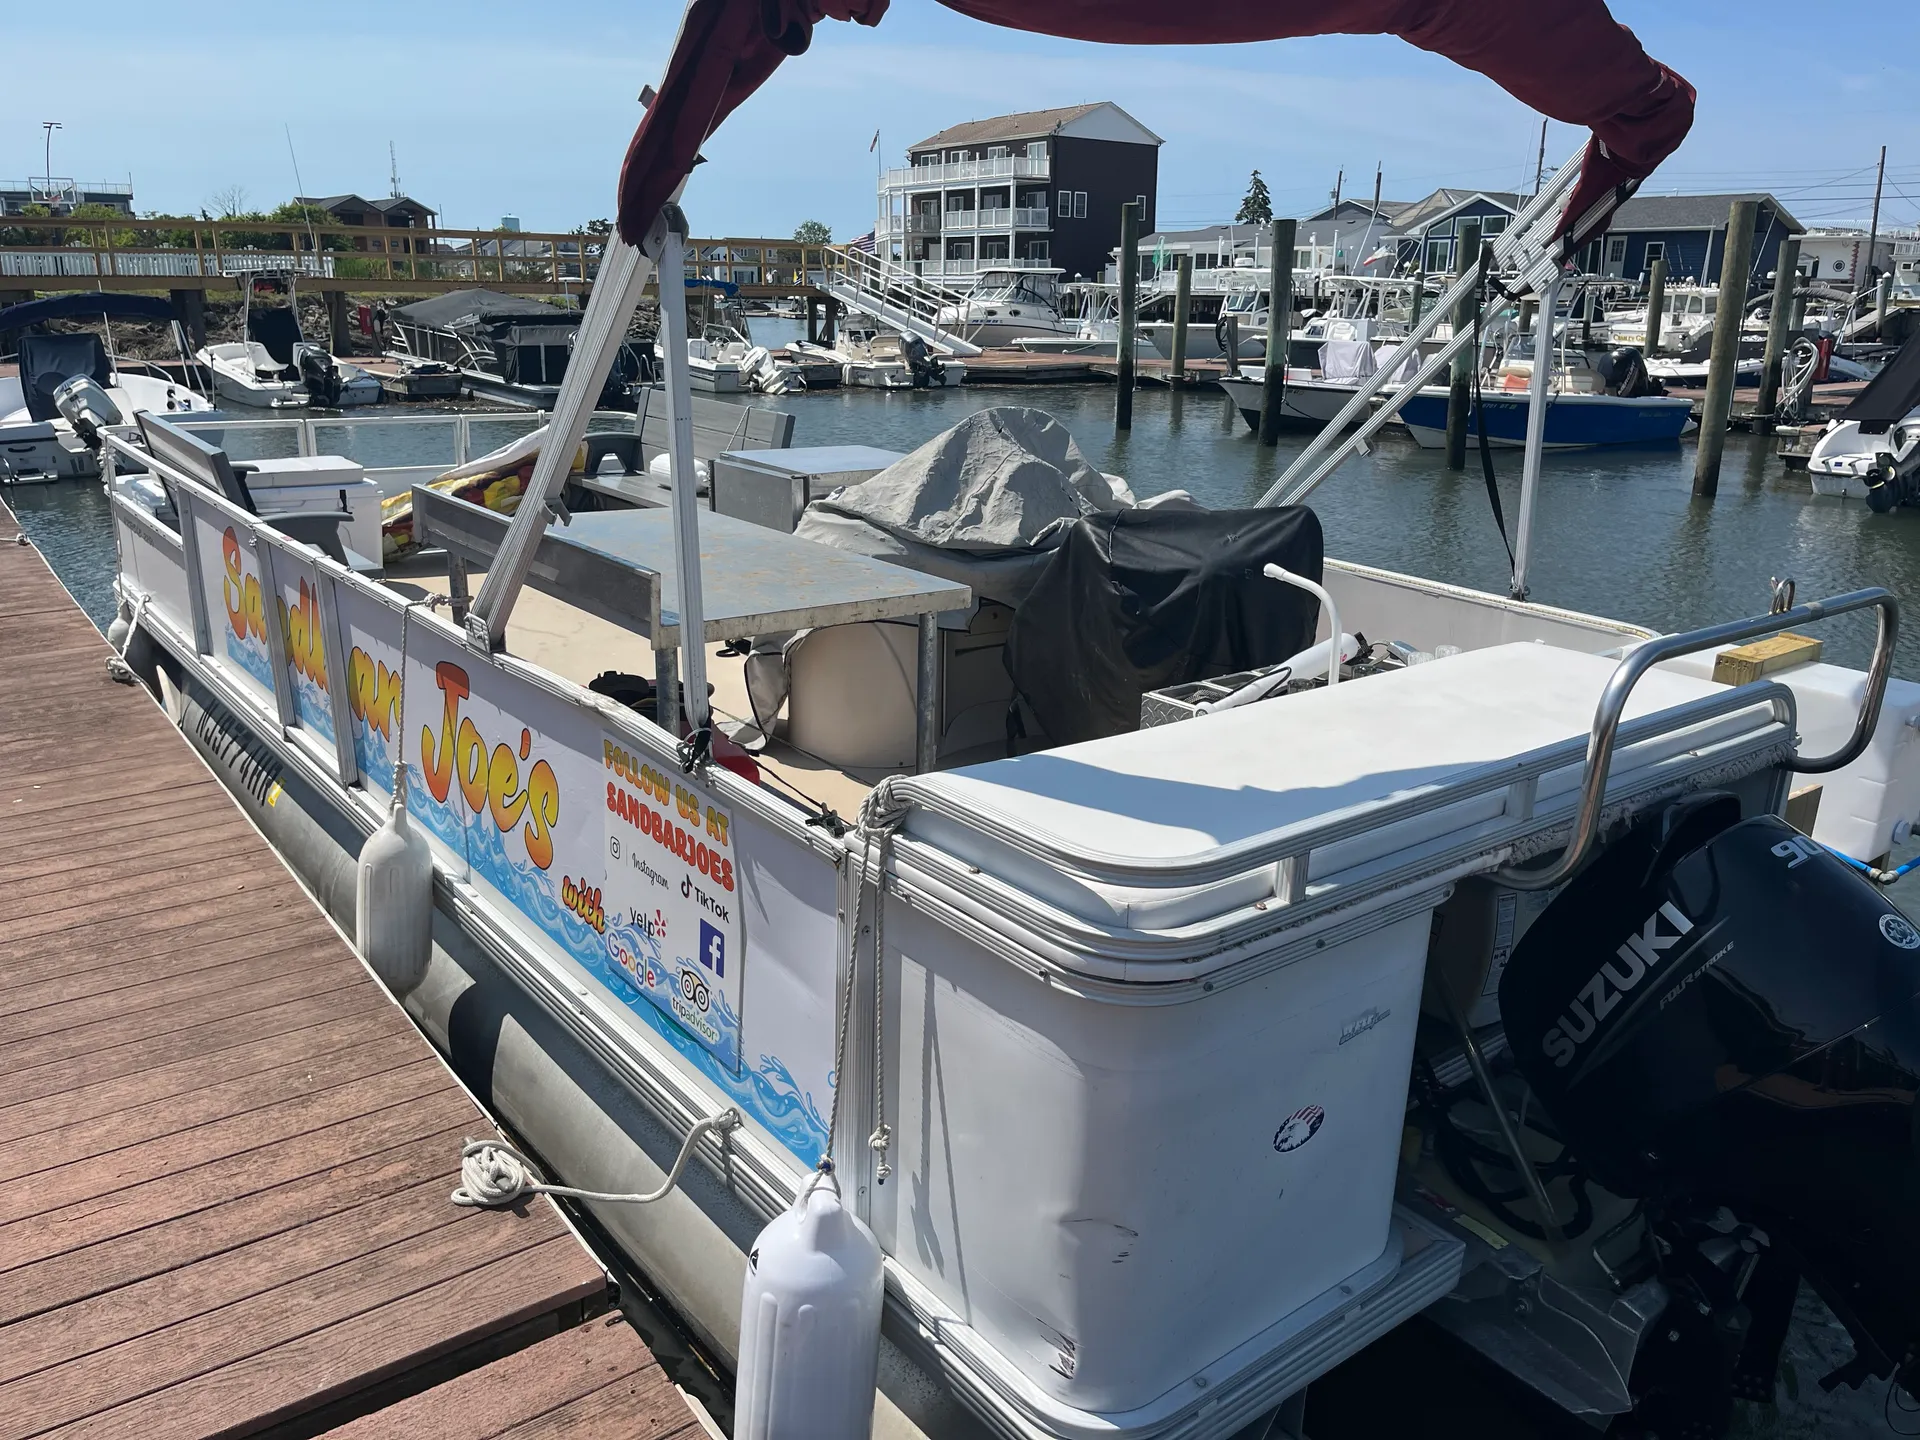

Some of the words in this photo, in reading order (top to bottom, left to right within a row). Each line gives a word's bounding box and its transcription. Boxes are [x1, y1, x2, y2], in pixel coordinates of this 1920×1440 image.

[421, 660, 560, 870] Joe's
[603, 739, 671, 807] FOLLOW
[675, 783, 701, 828] US
[706, 806, 729, 847] AT
[606, 781, 735, 892] SANDBARJOES
[1770, 835, 1824, 869] 90
[631, 852, 669, 890] Instagram
[561, 874, 605, 935] with
[629, 906, 655, 939] yelp
[694, 886, 730, 924] TikTok
[608, 932, 655, 988] Google
[1542, 900, 1694, 1068] SUZUKI
[1659, 972, 1695, 1011] FOUR
[1693, 940, 1735, 979] STROKE
[672, 997, 717, 1041] tripadvisor
